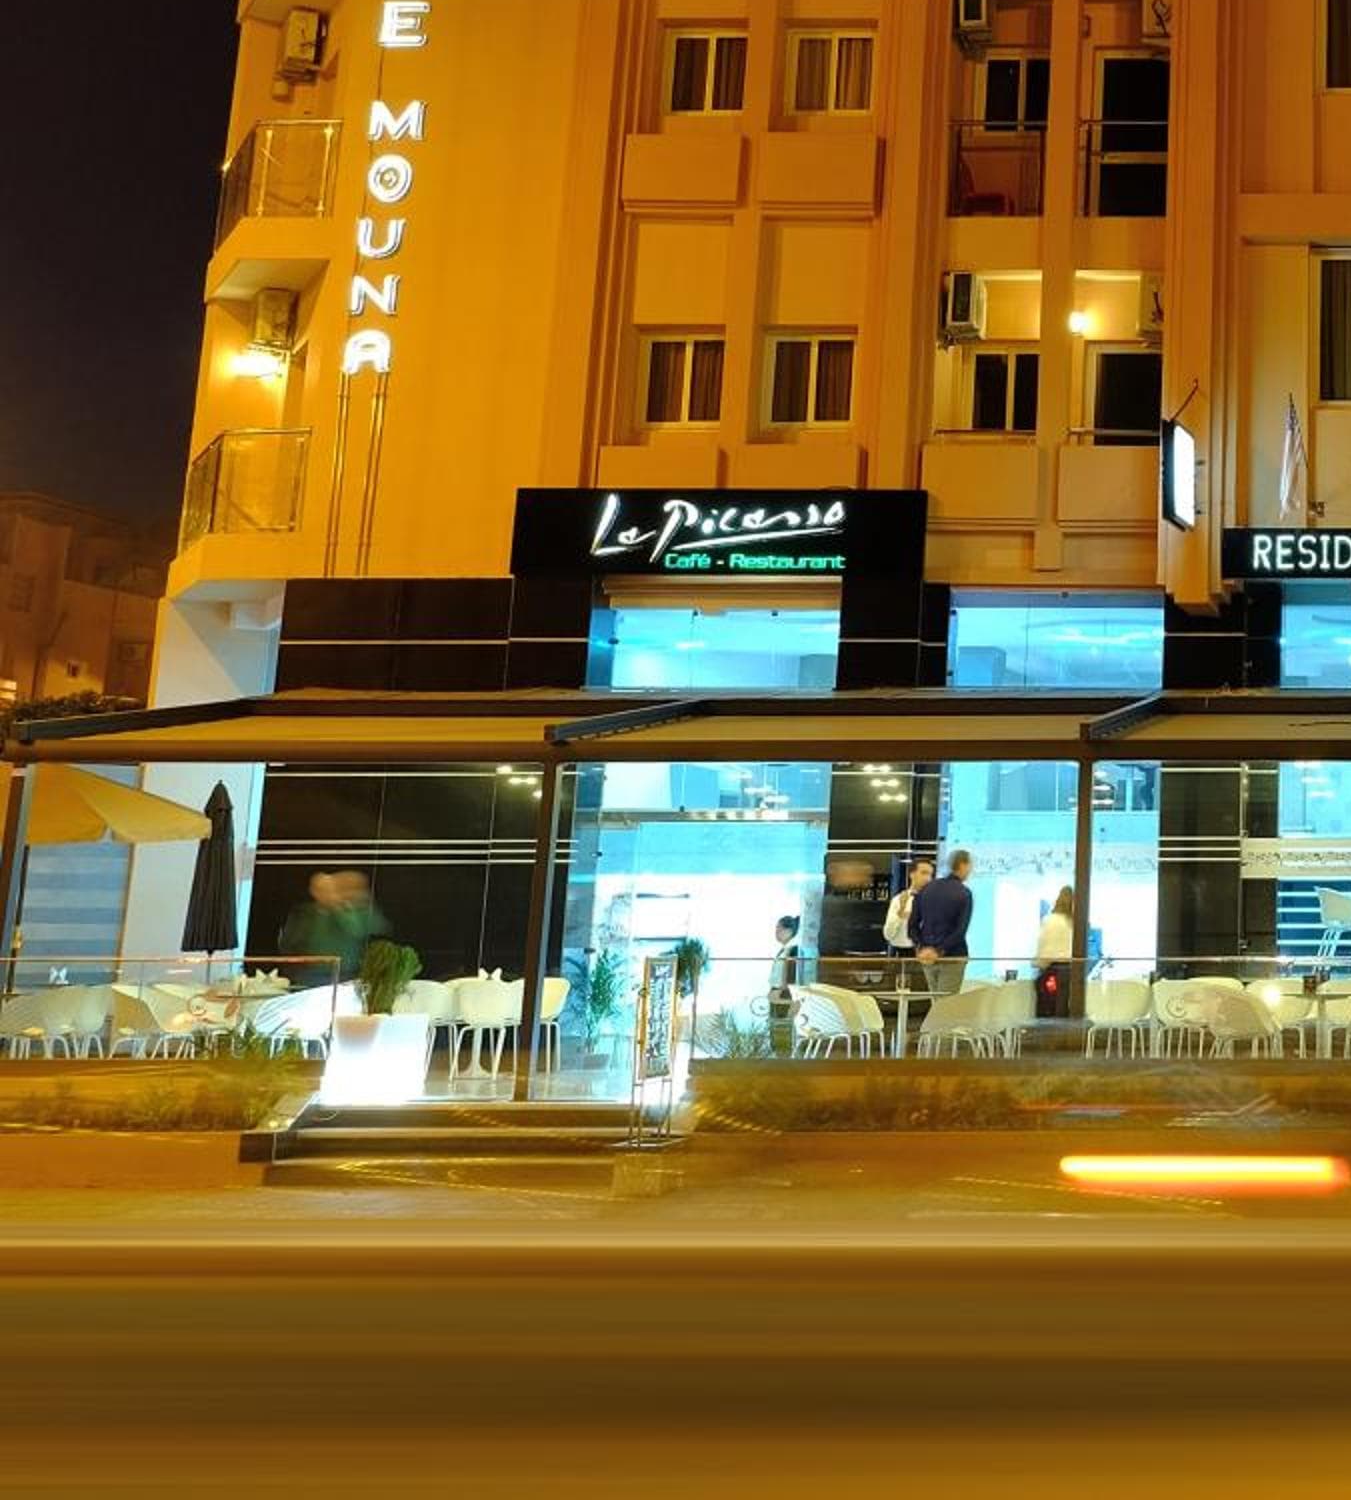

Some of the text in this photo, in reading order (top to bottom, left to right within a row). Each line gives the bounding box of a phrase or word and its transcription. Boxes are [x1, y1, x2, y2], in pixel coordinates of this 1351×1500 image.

[341, 99, 429, 375] MOUNA
[664, 553, 712, 569] Café
[729, 553, 847, 569] Restaurant
